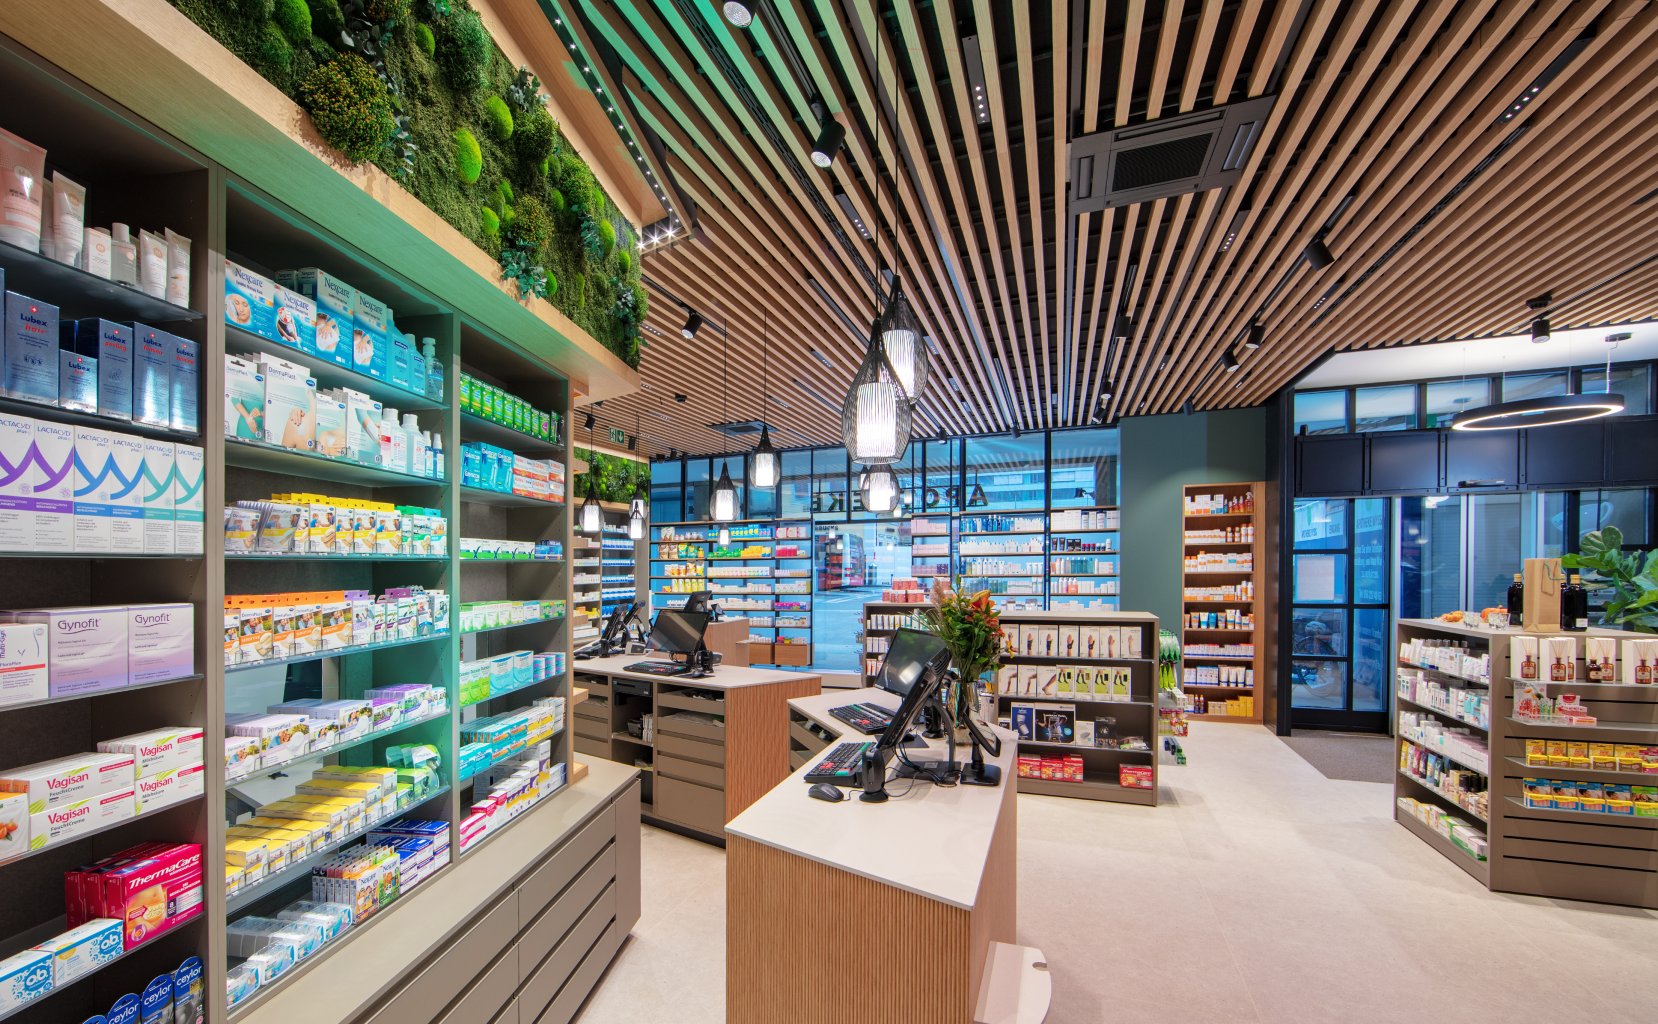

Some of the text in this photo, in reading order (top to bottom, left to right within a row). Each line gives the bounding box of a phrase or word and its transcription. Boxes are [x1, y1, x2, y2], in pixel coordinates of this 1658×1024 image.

[235, 268, 263, 287] Nexcare
[324, 276, 350, 298] Nexcare
[284, 290, 310, 310] Nexcare
[360, 296, 382, 315] Nexcare
[20, 313, 48, 327] Lubex
[104, 332, 126, 345] Lubex
[144, 337, 162, 348] Lubex
[176, 348, 194, 358] Lubex
[68, 362, 91, 372] Lubex
[268, 366, 296, 380] DermaPlast
[37, 426, 71, 436] LACTACYD
[78, 433, 109, 444] LACTACYD
[114, 439, 142, 448] LACTACYD
[146, 444, 172, 454] LACTACYD
[58, 618, 99, 632] Gynofit
[135, 614, 170, 625] Gynofit
[140, 744, 173, 757] Vagisan
[46, 772, 89, 790] Vagisan
[140, 776, 173, 792] Vagisan
[50, 784, 84, 798] FeuchtCreme
[48, 805, 90, 825] Vagisan
[50, 818, 86, 832] FeuchtCreme
[129, 854, 200, 889] ThermaCare
[100, 934, 120, 950] o.b.
[26, 968, 48, 986] o.b.
[176, 966, 202, 986] ceylor
[144, 984, 172, 1006] ceylor
[108, 1004, 139, 1024] ceylor
